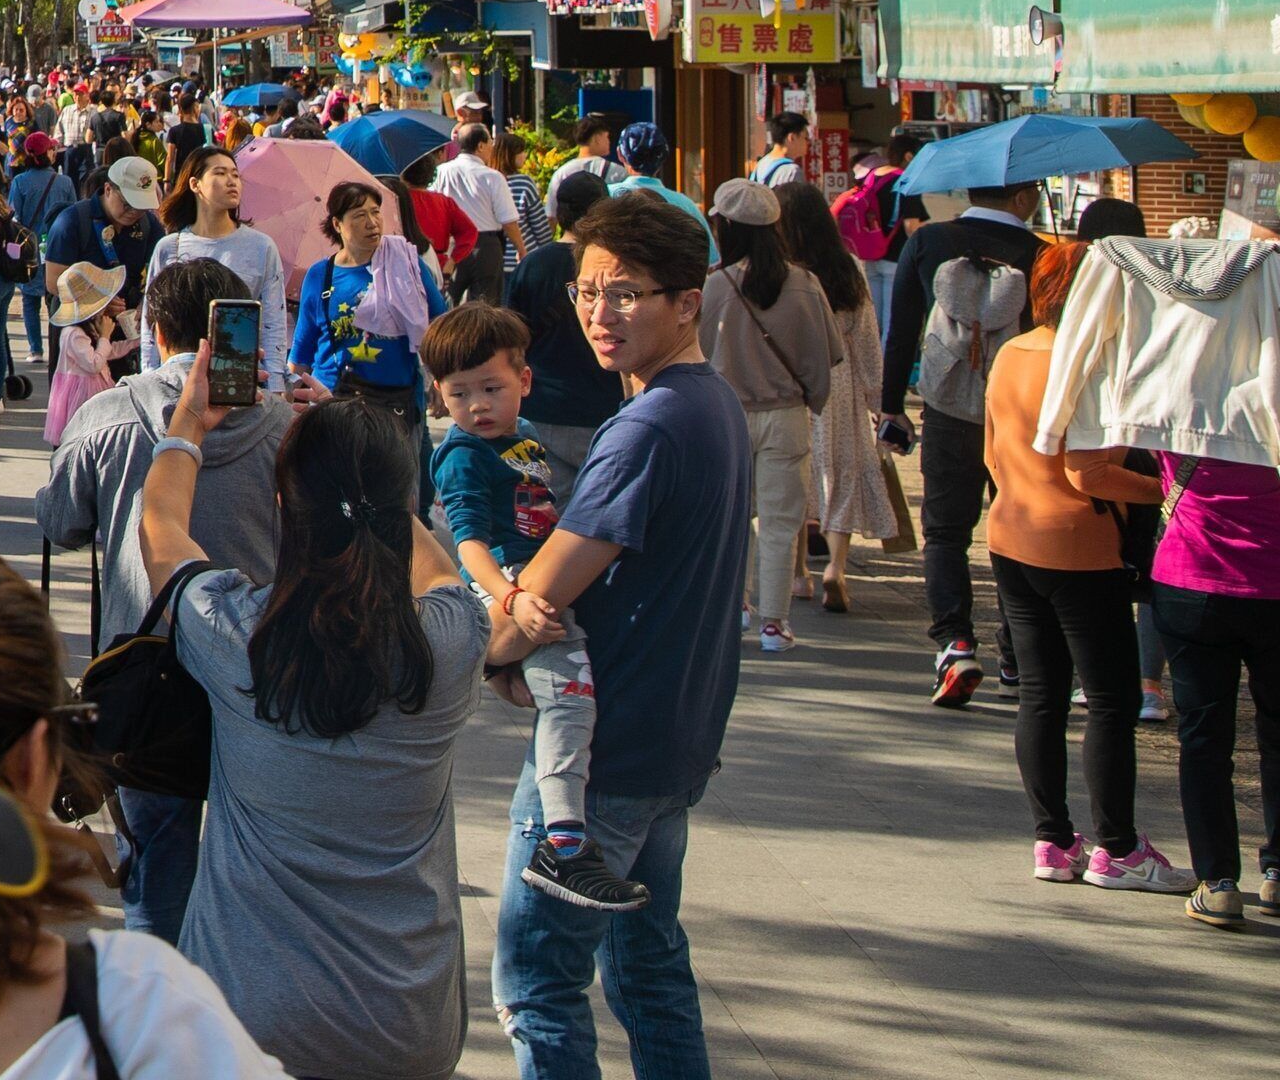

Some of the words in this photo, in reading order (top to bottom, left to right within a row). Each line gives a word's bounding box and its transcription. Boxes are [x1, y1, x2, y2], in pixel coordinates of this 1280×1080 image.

[717, 23, 813, 54] 售票處
[827, 175, 846, 188] 30
